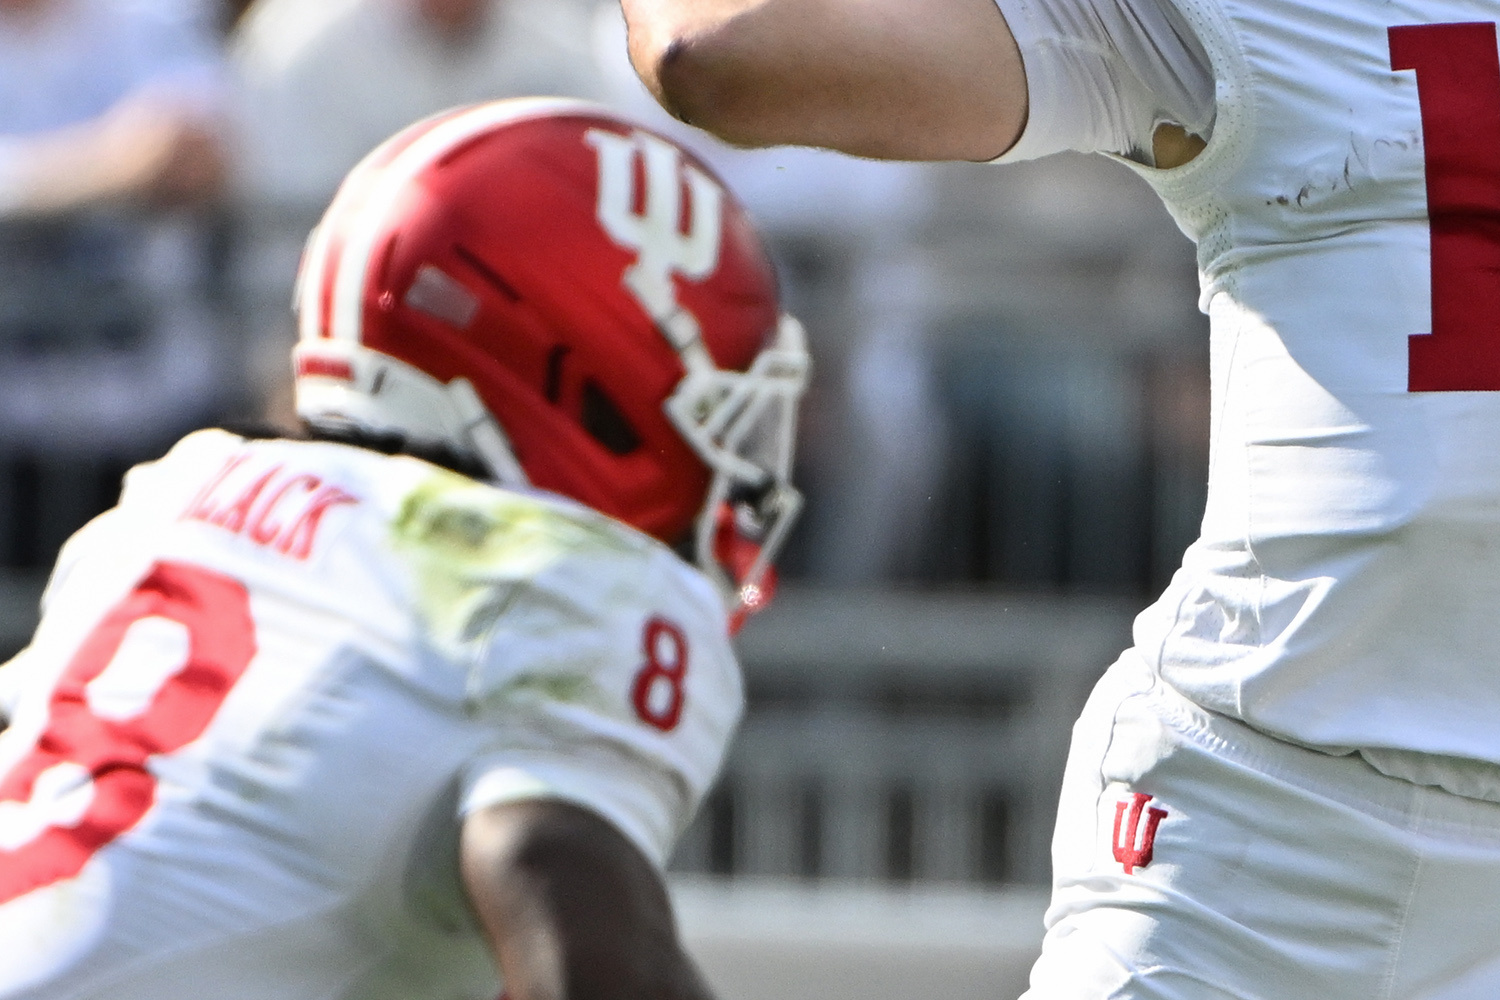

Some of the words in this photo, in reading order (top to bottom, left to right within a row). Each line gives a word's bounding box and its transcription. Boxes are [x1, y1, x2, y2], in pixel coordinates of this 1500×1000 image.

[178, 452, 363, 562] LACK
[0, 557, 259, 902] 8
[631, 615, 690, 733] 8
